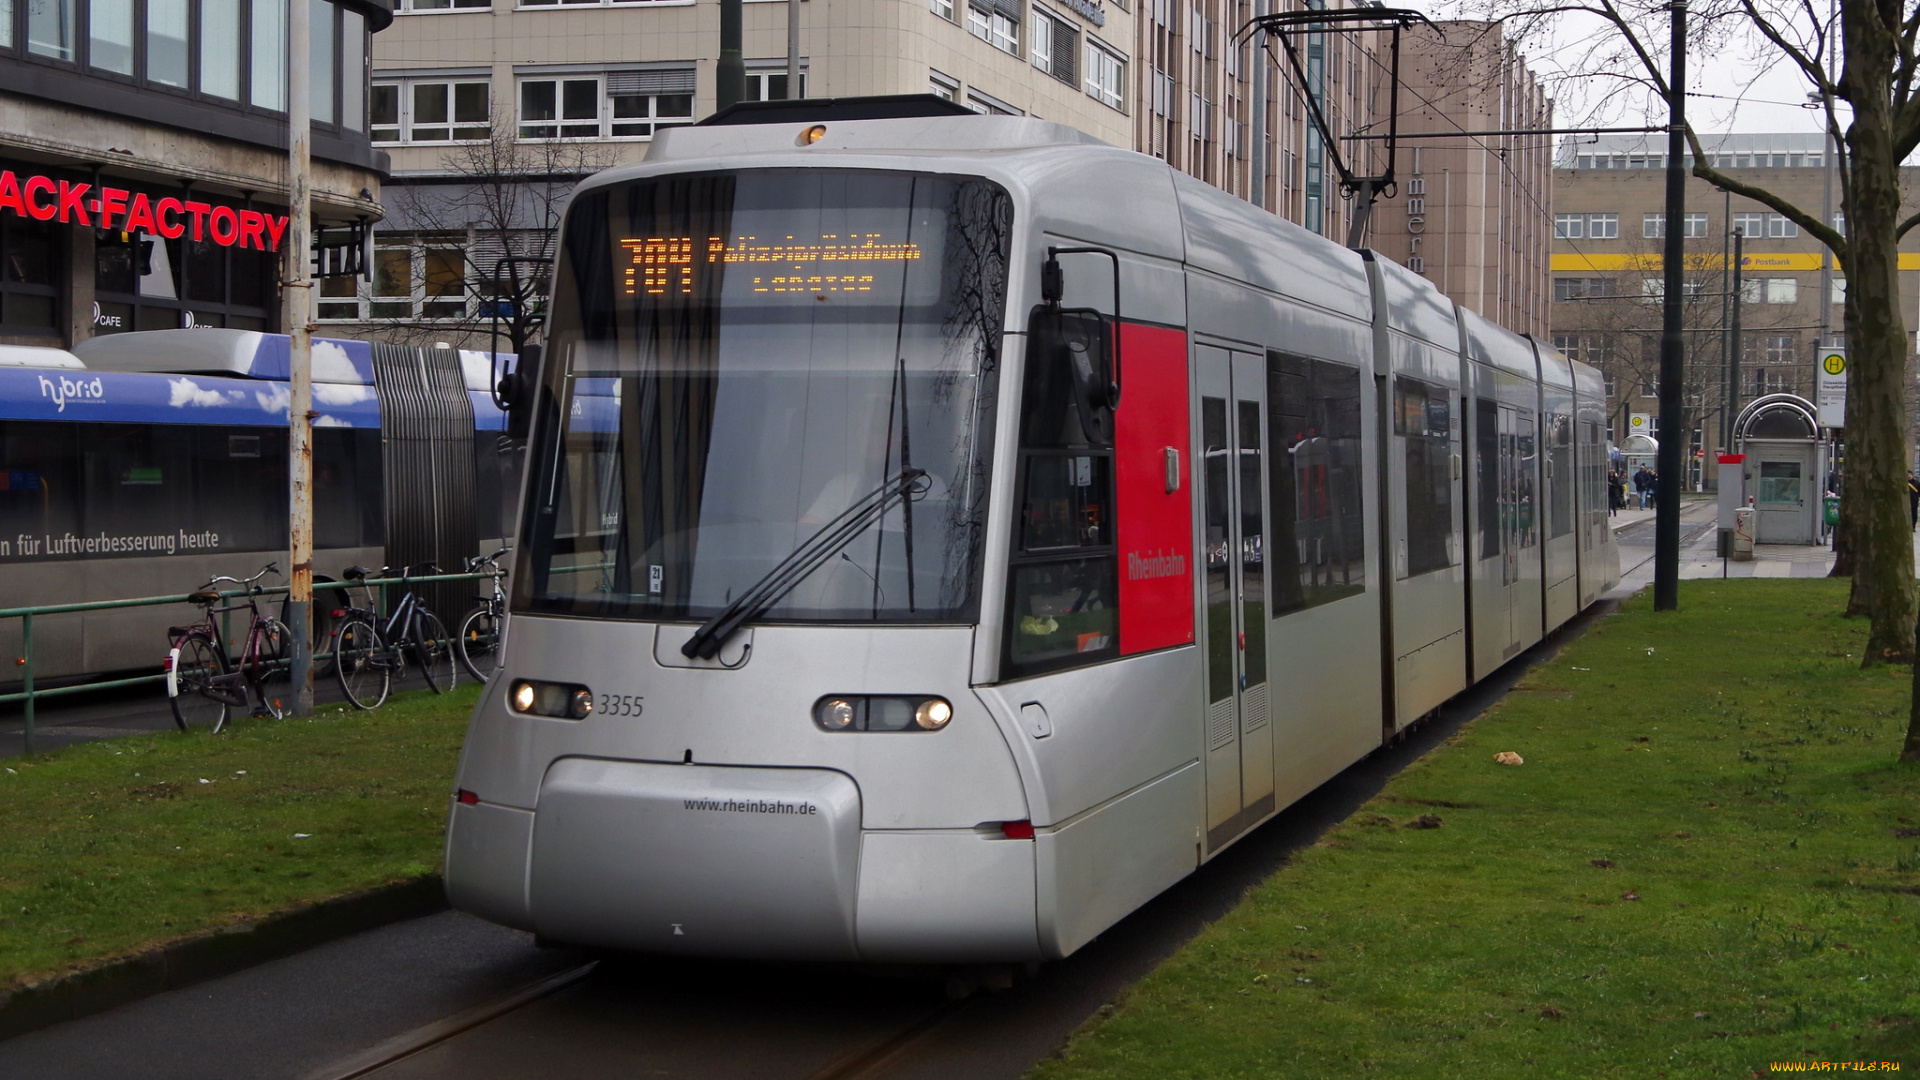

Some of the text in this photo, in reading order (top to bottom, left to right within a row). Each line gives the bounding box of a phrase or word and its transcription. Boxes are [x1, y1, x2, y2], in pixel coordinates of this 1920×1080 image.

[621, 237, 691, 293] 704
[100, 315, 121, 327] CAFE
[38, 375, 103, 412] hybrid
[17, 534, 41, 555] für
[46, 532, 175, 555] Luftverbesserung
[179, 529, 219, 548] heute
[652, 567, 660, 580] 21
[1128, 547, 1185, 580] Rheinbahn
[598, 694, 645, 717] 3355
[684, 798, 817, 815] www.rheinbahn.de
